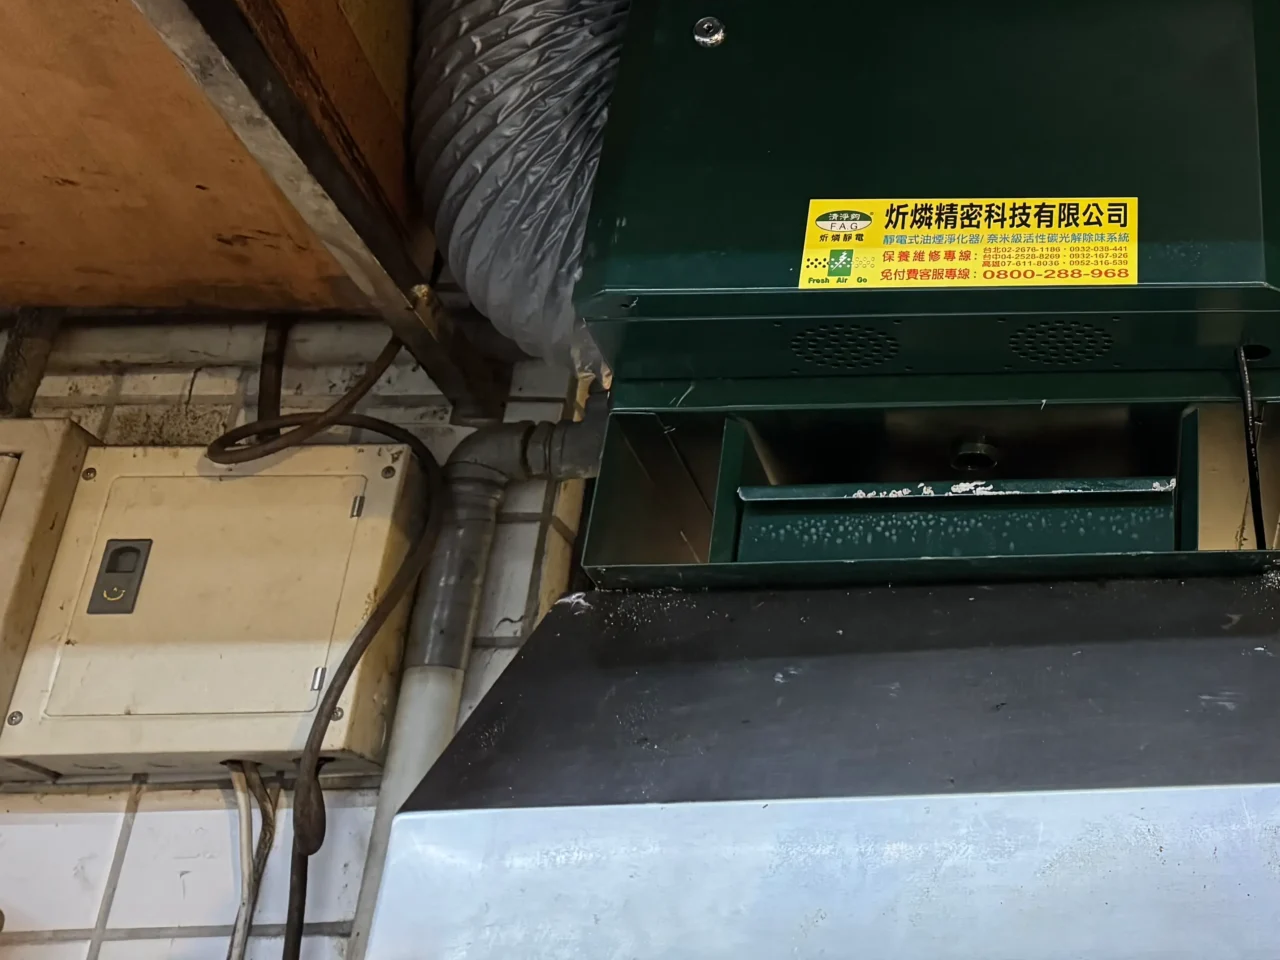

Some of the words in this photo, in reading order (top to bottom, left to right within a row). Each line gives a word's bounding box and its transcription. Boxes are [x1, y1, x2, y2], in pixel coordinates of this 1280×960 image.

[884, 202, 1128, 229] 炘燐精密科技有限公司
[983, 268, 1130, 280] 0800-288-968
